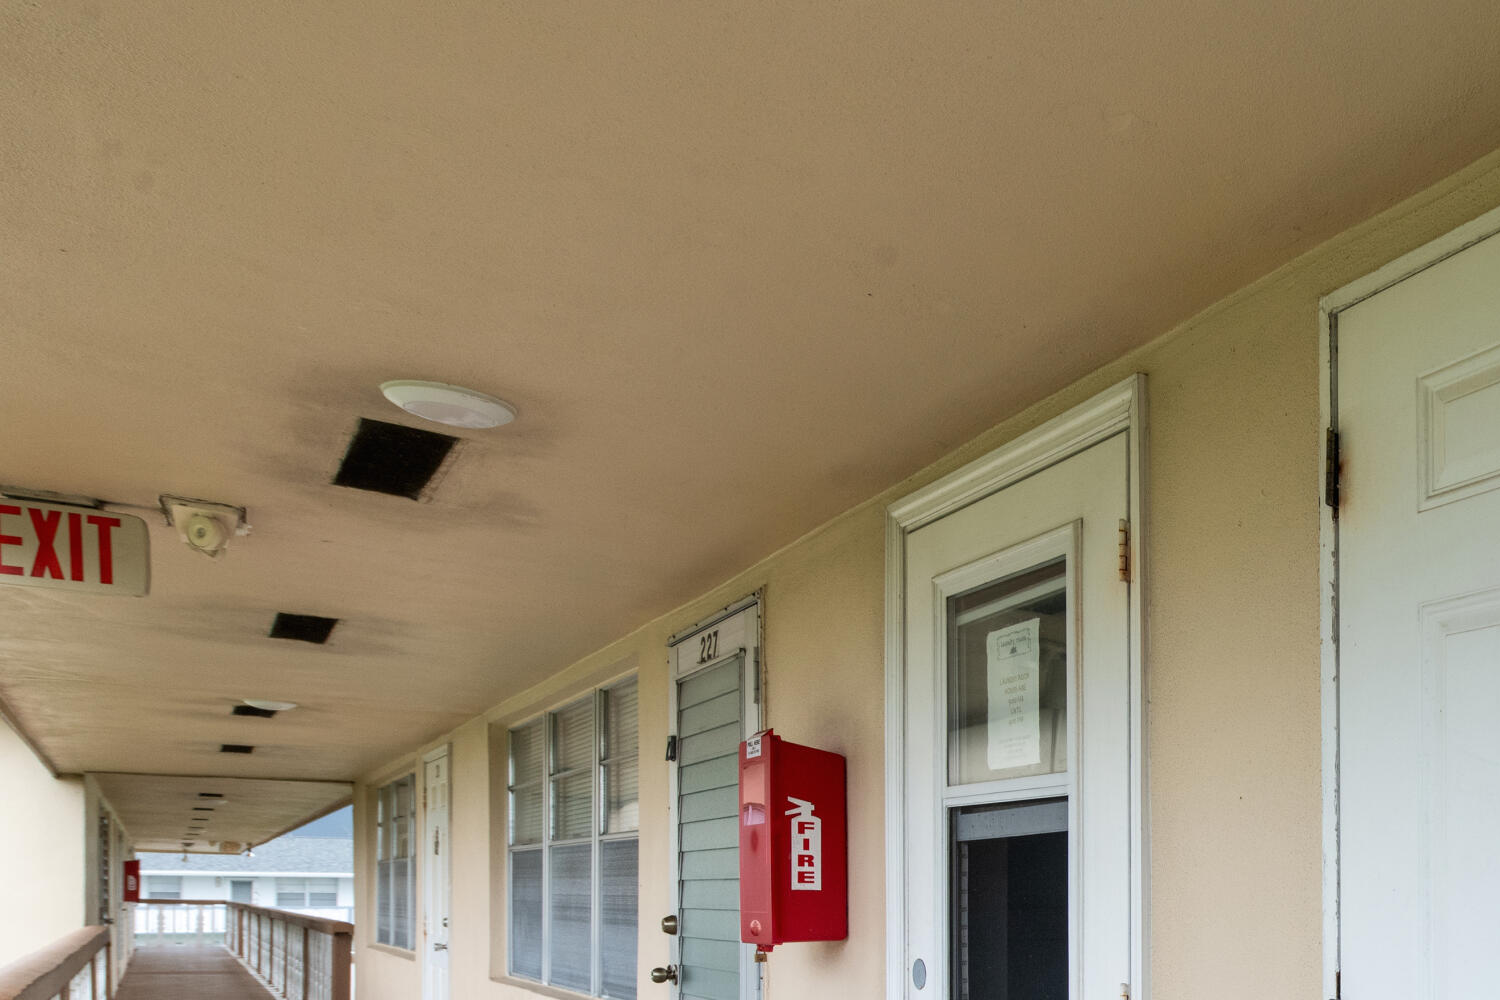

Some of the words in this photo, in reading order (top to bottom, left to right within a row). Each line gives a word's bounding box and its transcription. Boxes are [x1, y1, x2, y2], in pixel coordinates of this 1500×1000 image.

[0, 504, 121, 585] EXIT
[699, 630, 719, 664] 227
[798, 821, 815, 884] FIRE
